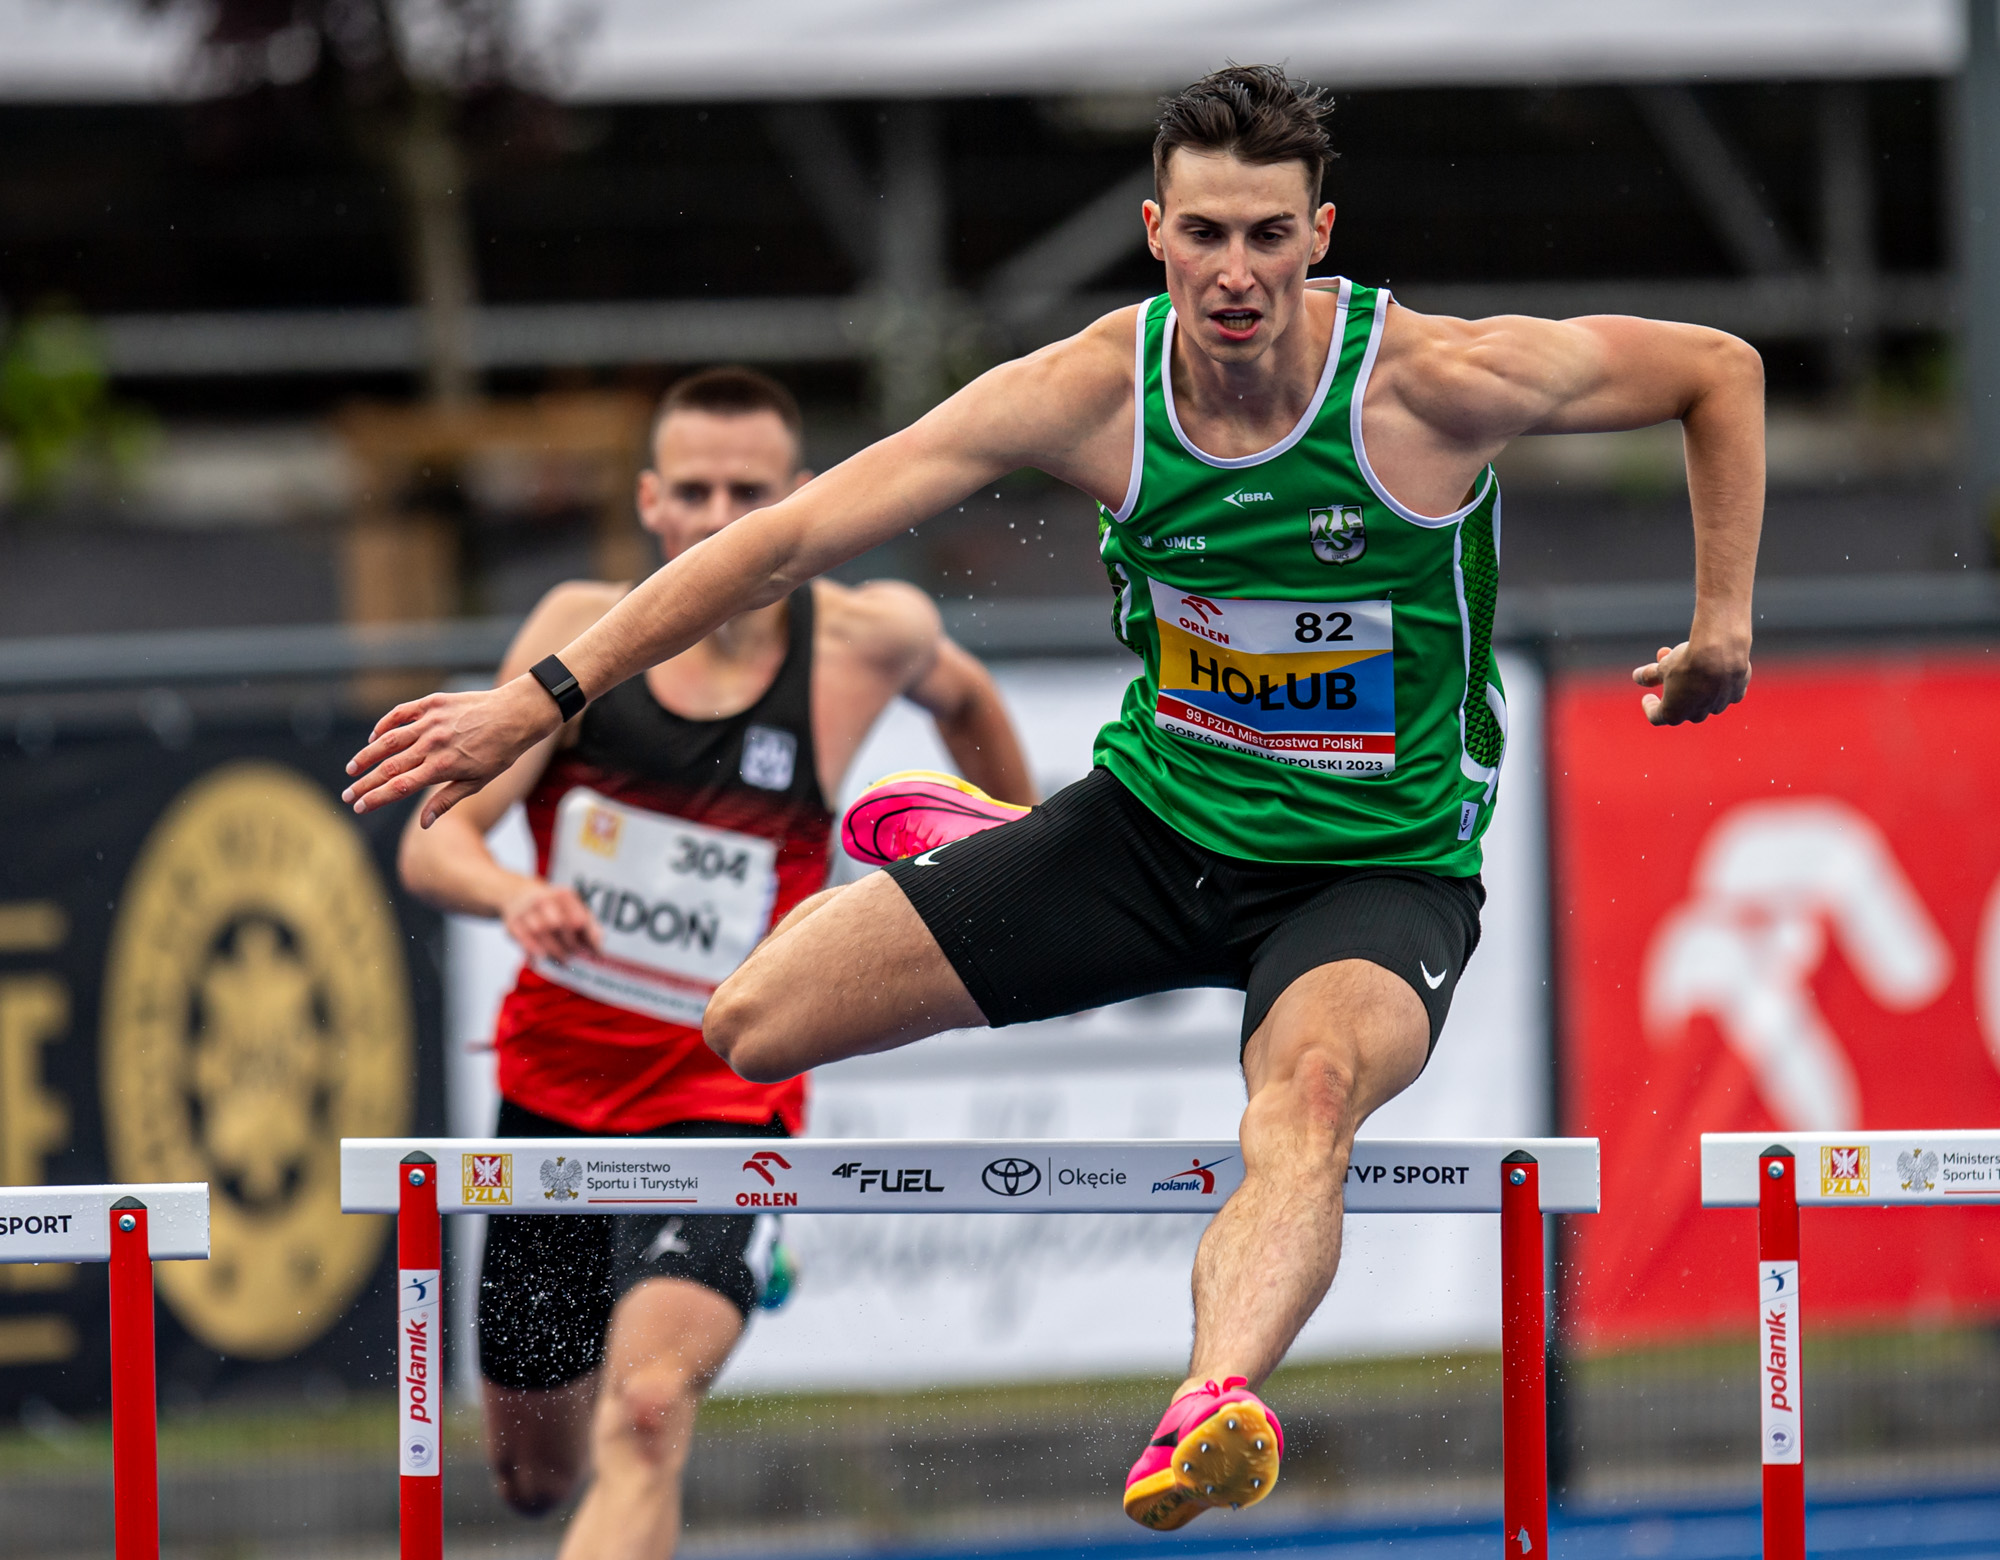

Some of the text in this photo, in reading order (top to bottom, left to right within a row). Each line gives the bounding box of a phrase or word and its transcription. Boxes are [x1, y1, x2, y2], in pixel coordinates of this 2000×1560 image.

[1163, 536, 1206, 550] UMCS
[1179, 617, 1229, 645] ORLEN
[1294, 611, 1354, 643] 82
[1190, 648, 1358, 711] HOŁUB
[1186, 708, 1363, 750] 99. PZLA Mistrzostwa Polski
[1165, 723, 1229, 750] GORZÓW
[1346, 760, 1383, 771] 2023
[671, 834, 750, 883] 304
[587, 1161, 671, 1173] Ministerstwo
[1393, 1166, 1469, 1184] SPORT
[1943, 1168, 1985, 1183] Sportu
[587, 1177, 630, 1191] Sportu
[641, 1177, 699, 1191] Turystyki
[832, 1162, 945, 1193] 4F FUEL
[1058, 1168, 1127, 1189] Okęcie
[1823, 1180, 1867, 1194] PZLA
[465, 1187, 510, 1203] PZLA
[735, 1192, 798, 1207] ORLEN
